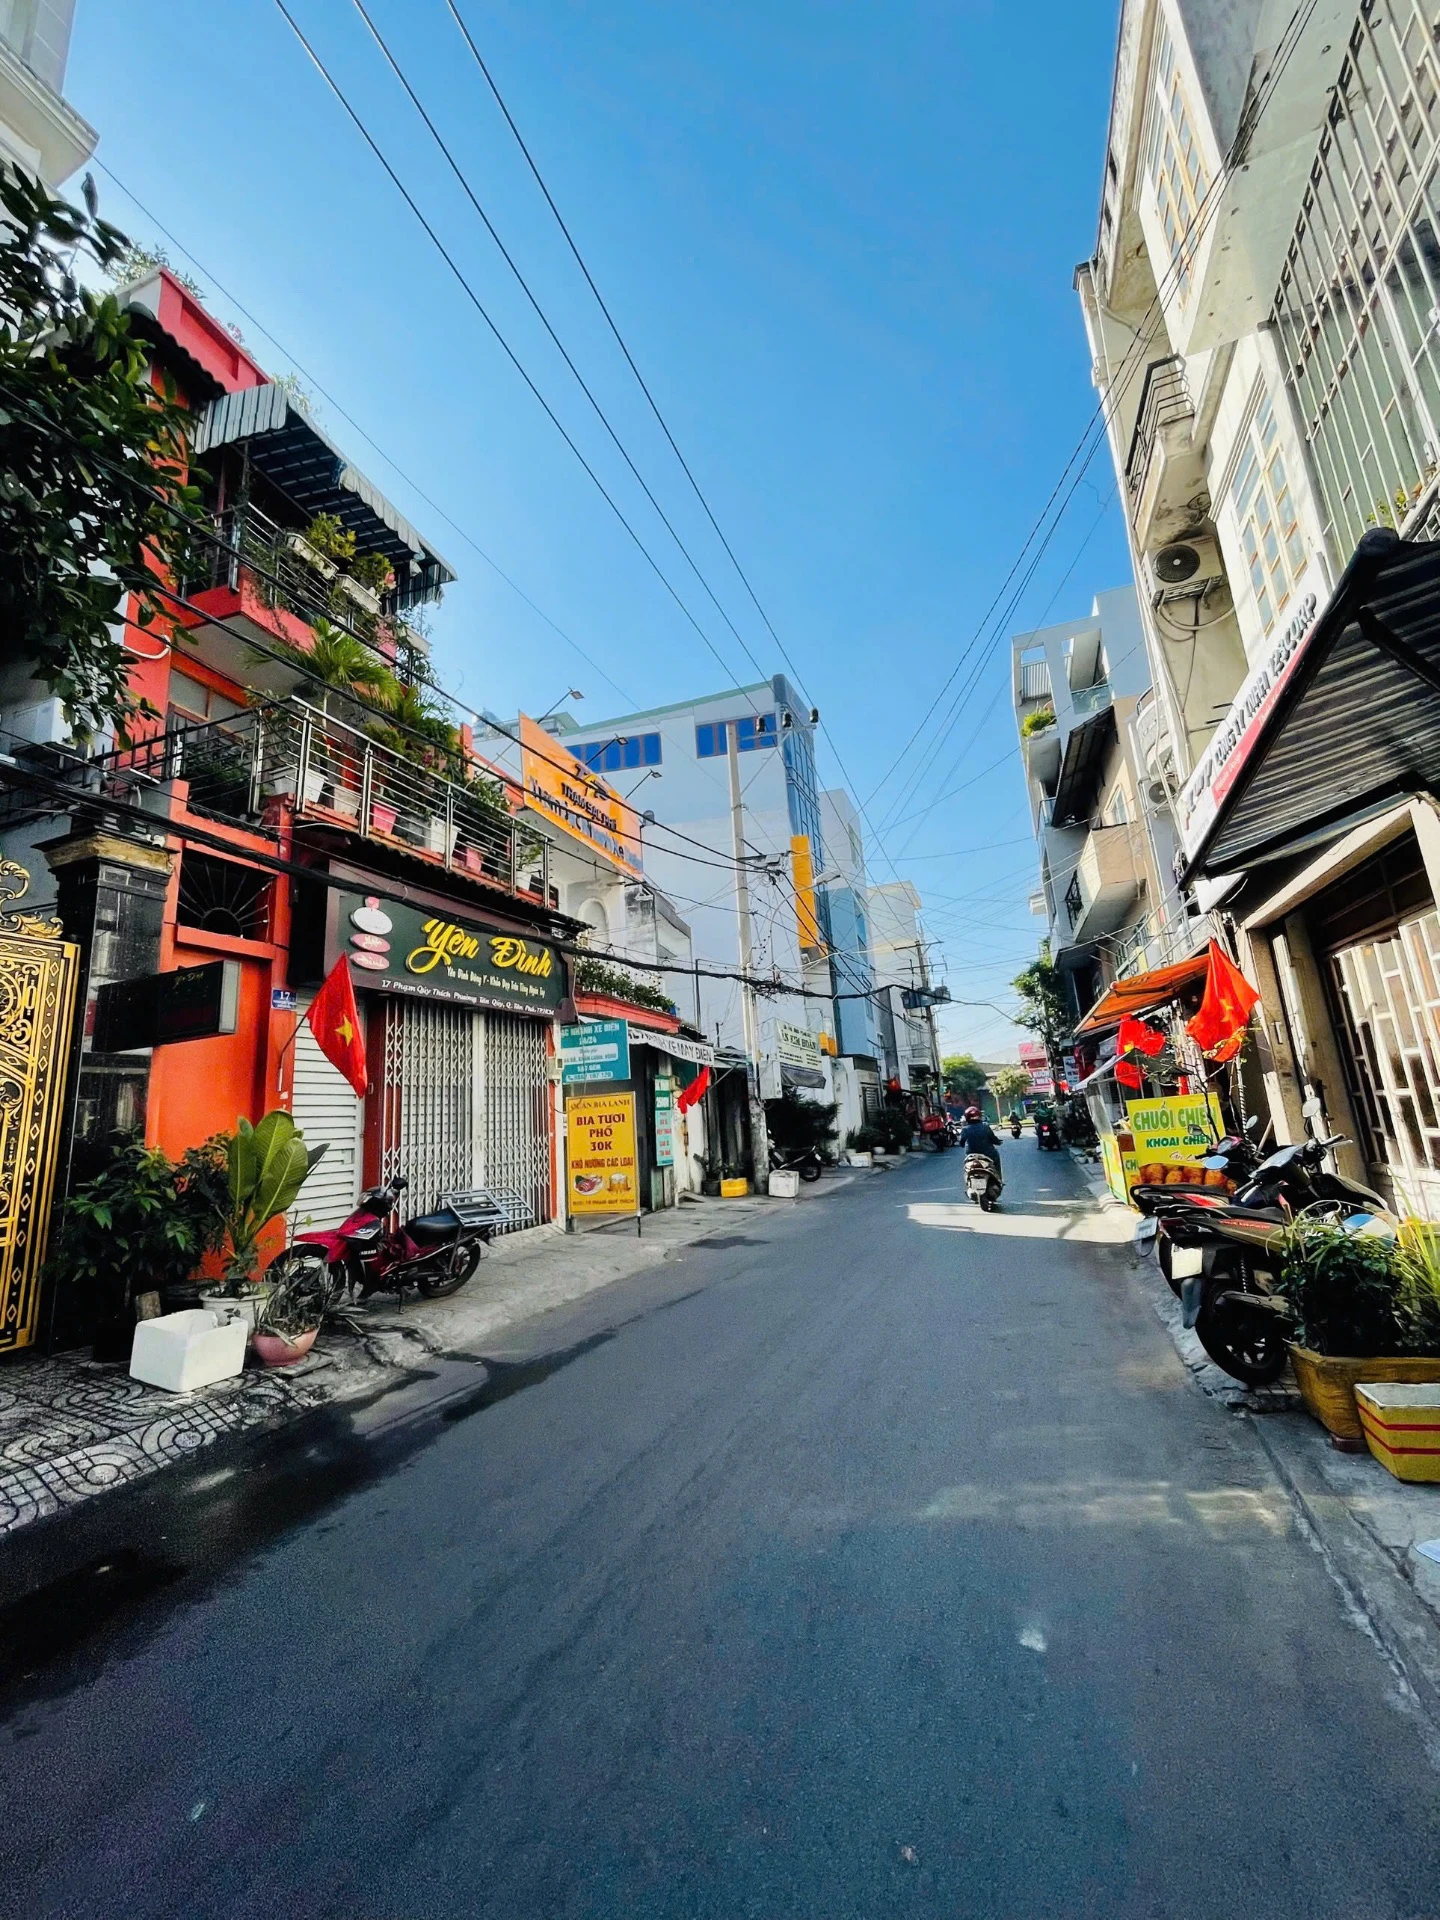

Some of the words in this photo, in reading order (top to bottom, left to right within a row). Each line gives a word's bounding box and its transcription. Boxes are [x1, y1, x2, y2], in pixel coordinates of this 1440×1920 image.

[405, 918, 480, 974] Yên
[488, 935, 553, 979] Đình
[381, 979, 392, 988] 17
[393, 981, 416, 992] Phạm
[432, 988, 451, 998] Thích
[280, 991, 291, 1000] 17
[594, 1024, 603, 1033] XE
[576, 1116, 595, 1126] BIA
[1133, 1101, 1175, 1132] CHUỐI
[589, 1125, 613, 1138] PHỐ
[590, 1141, 613, 1151] 30K
[1146, 1137, 1179, 1148] KHOAI
